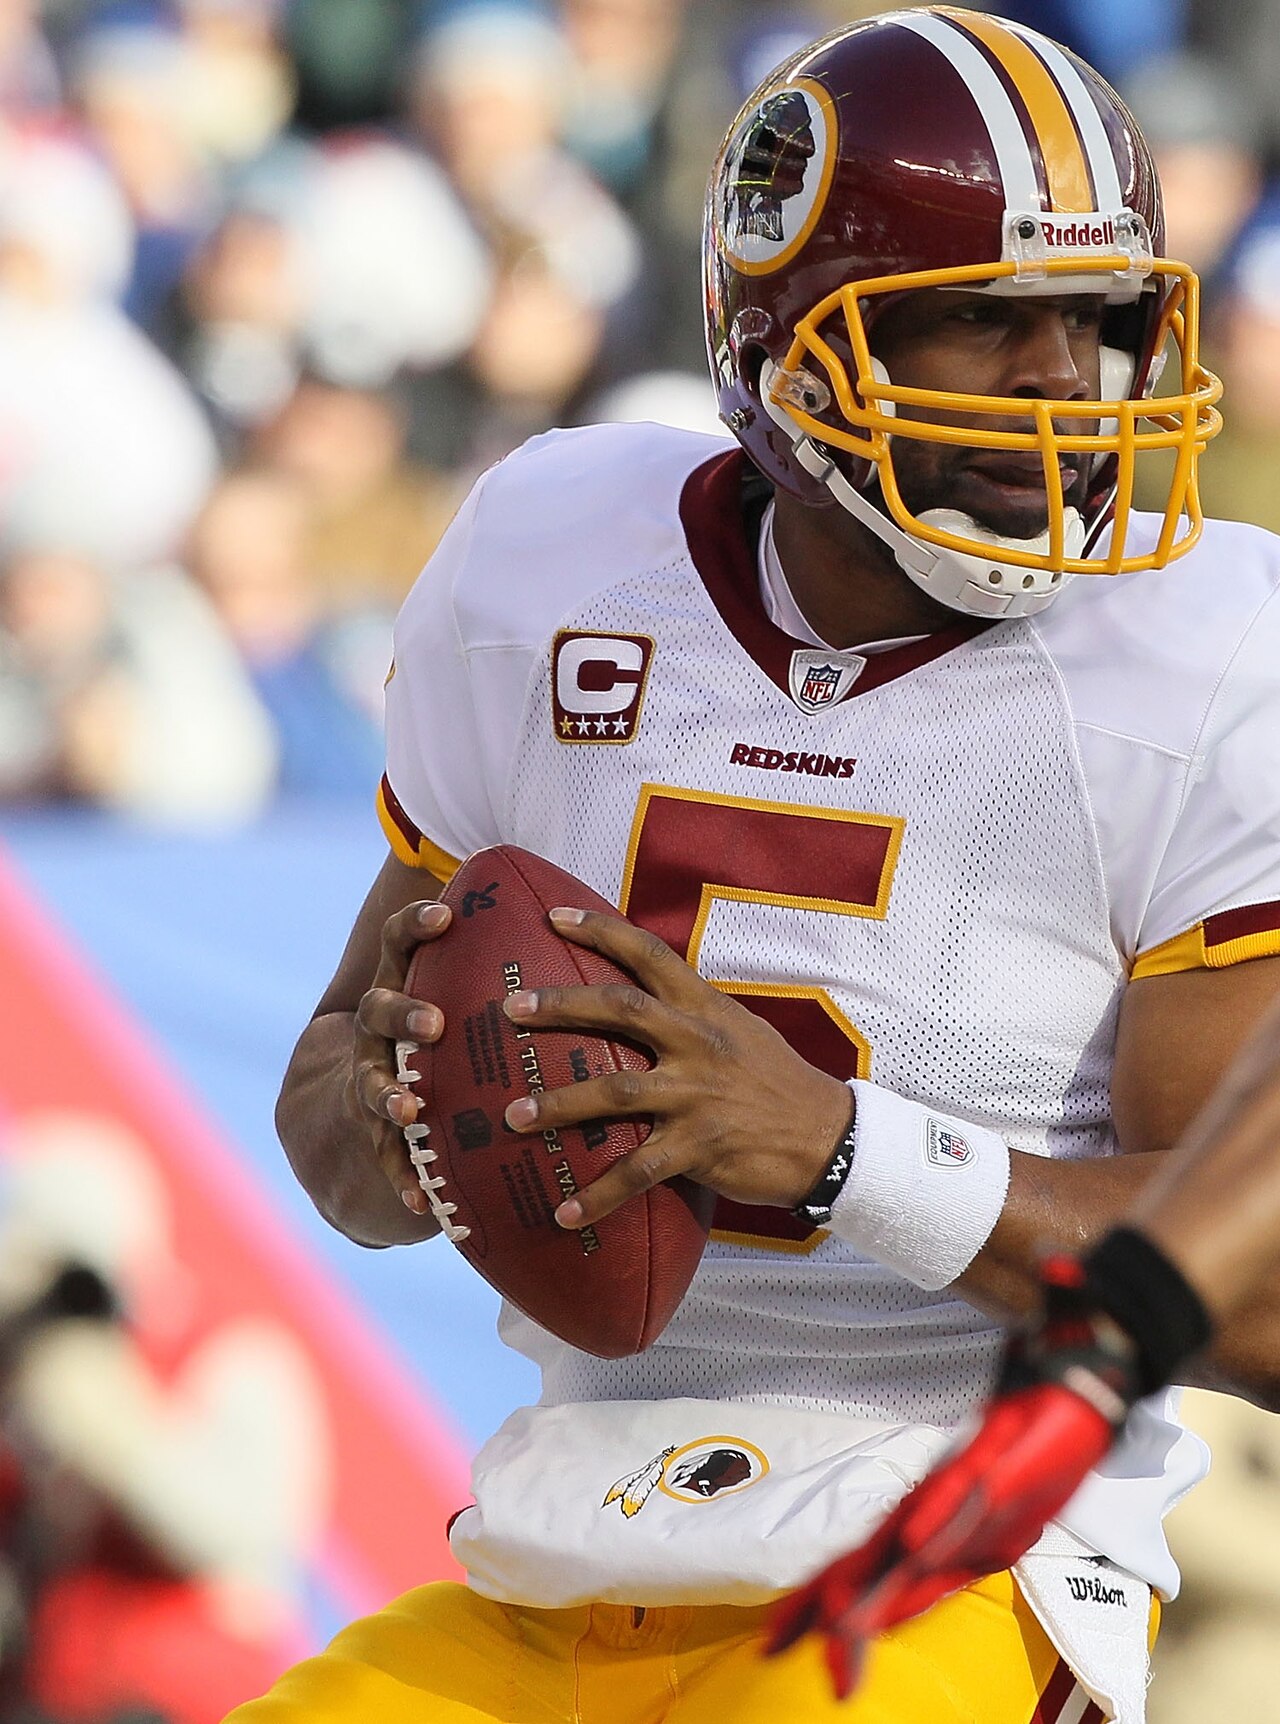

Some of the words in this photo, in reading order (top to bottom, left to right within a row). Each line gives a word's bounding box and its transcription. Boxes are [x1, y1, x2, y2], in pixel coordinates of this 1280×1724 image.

[1040, 220, 1115, 246] Riddell
[557, 638, 643, 714] C
[803, 681, 832, 703] NFL
[730, 743, 857, 778] REDSKINS
[618, 783, 907, 1256] 5
[521, 1046, 562, 1154] FOBALL
[950, 1138, 965, 1159] NFL
[556, 1160, 600, 1254] NANAL
[1065, 1577, 1128, 1608] Wilson
